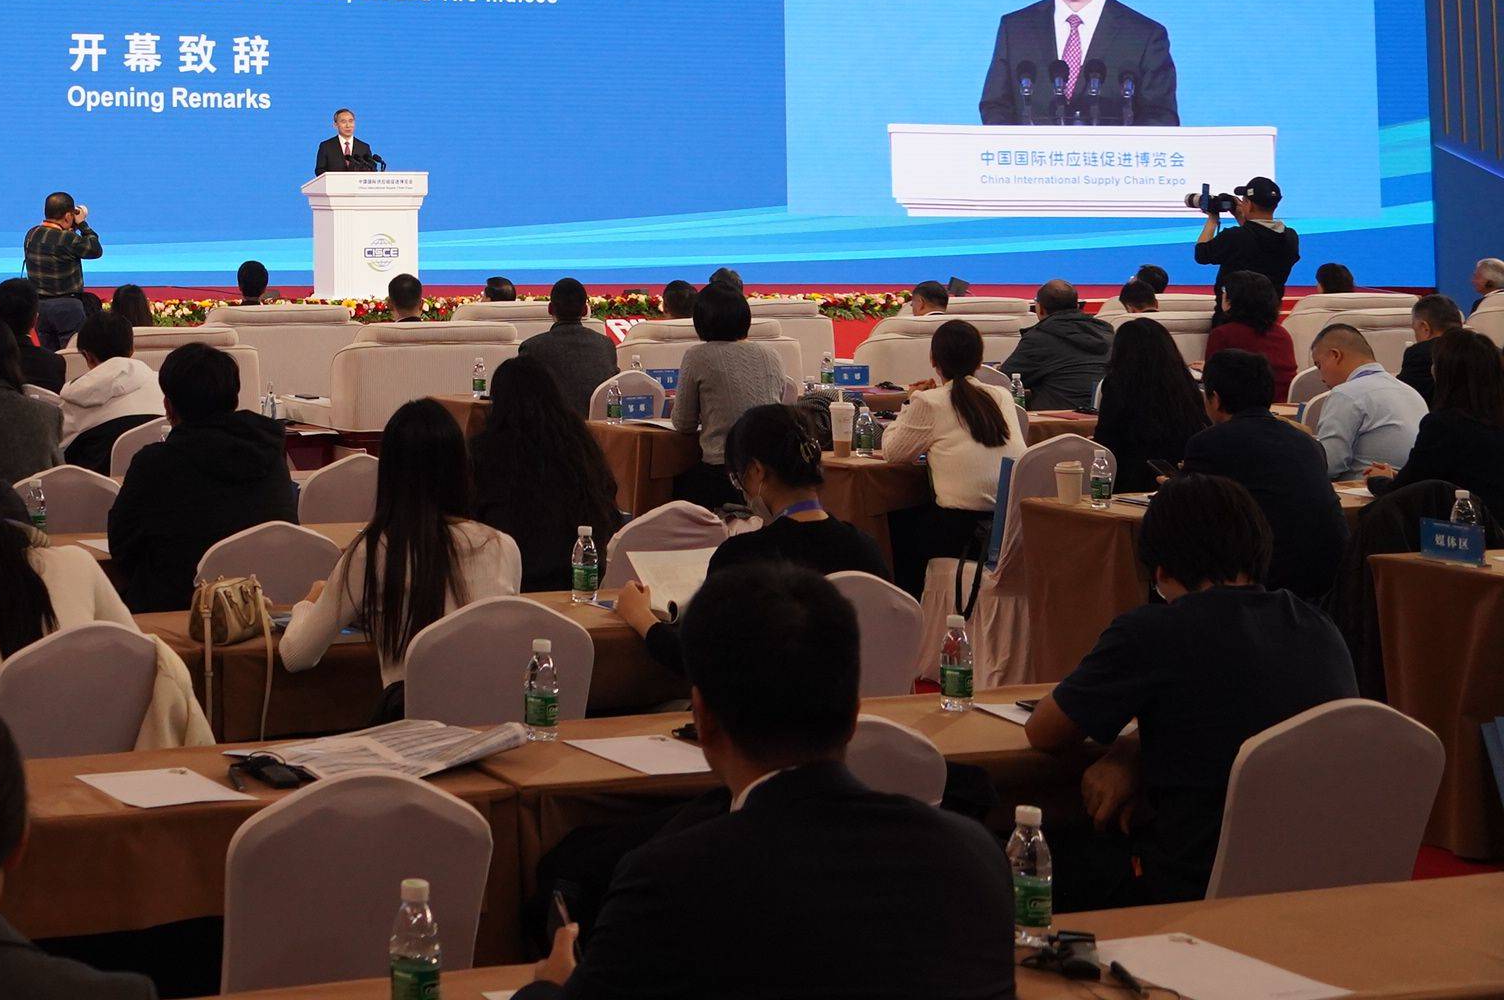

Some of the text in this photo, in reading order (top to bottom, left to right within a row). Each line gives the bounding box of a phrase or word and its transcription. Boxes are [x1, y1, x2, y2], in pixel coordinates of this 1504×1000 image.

[68, 33, 270, 75] 开幕致辞
[67, 85, 271, 113] Opening Remarks
[980, 150, 1185, 168] 中国国际供应链促进博览会
[980, 174, 1186, 187] China International Supply Chain Expo
[364, 248, 399, 258] CISCE
